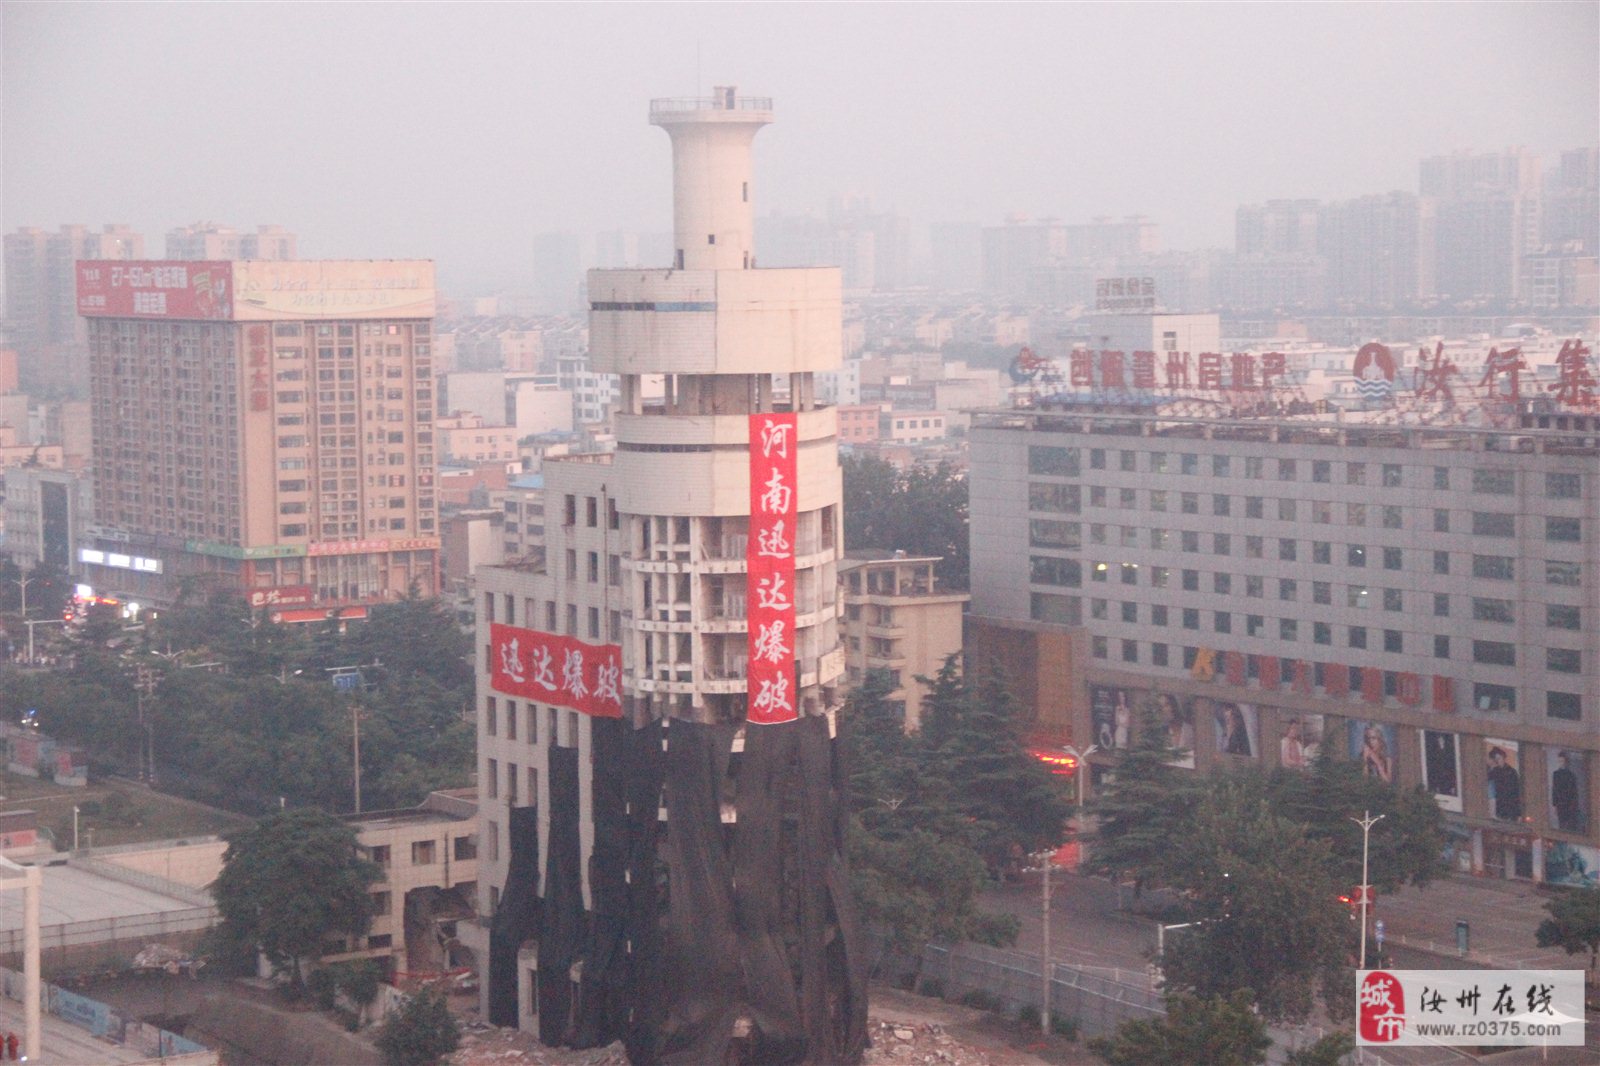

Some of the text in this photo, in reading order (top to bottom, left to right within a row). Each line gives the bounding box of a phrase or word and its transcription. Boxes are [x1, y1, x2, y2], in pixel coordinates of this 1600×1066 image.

[753, 419, 793, 713] 河南迅达爆破
[501, 637, 622, 706] 迅达爆破
